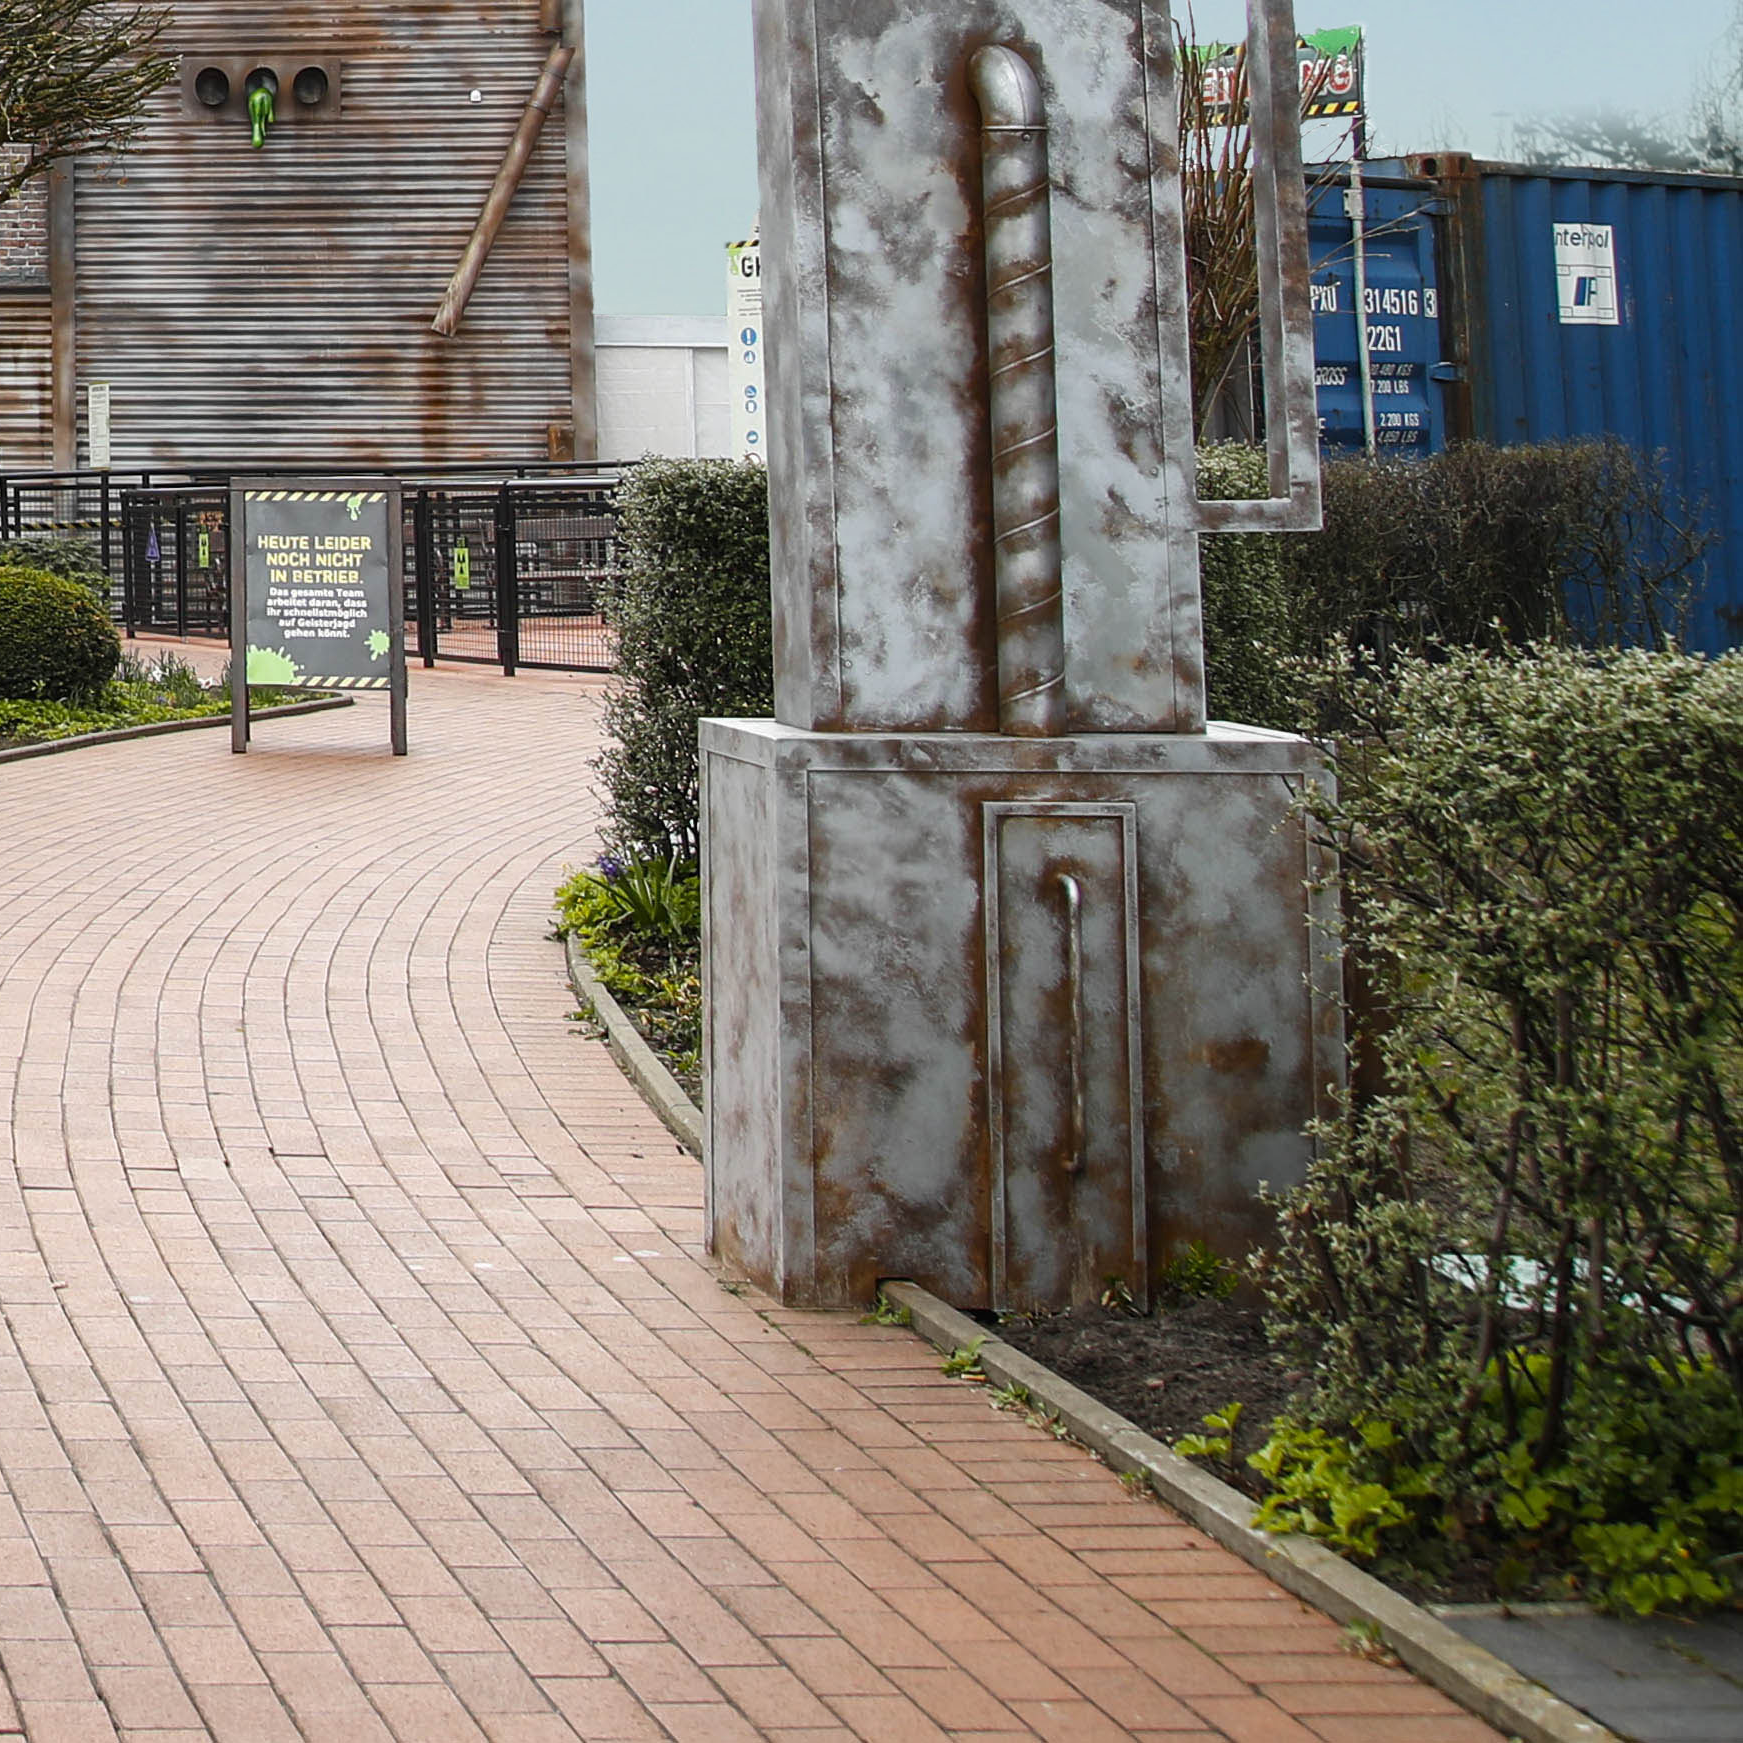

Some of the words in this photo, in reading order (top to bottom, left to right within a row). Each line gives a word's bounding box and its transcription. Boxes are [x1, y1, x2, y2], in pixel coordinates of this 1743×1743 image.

[1310, 285, 1337, 312] PXU
[1365, 288, 1418, 315] 314516
[1425, 291, 1437, 317] 3
[257, 535, 310, 550] HEUTE
[314, 536, 372, 551] LEIDER
[266, 552, 310, 567] NOCH
[315, 552, 364, 568] NICHT
[270, 569, 288, 584] IN
[292, 569, 364, 585] BETRIEB.
[269, 587, 289, 596] Das
[291, 588, 334, 598] gesamte
[336, 588, 365, 598] Team
[267, 597, 307, 607] arbeitet
[308, 597, 341, 609] daran,
[343, 598, 367, 608] dass
[267, 607, 281, 616] ihr
[283, 607, 368, 619] schnellstmöglich
[279, 617, 295, 627] auf
[297, 618, 356, 630] Geisterjagd
[284, 628, 315, 638] gehen
[317, 628, 351, 638] könnt.
